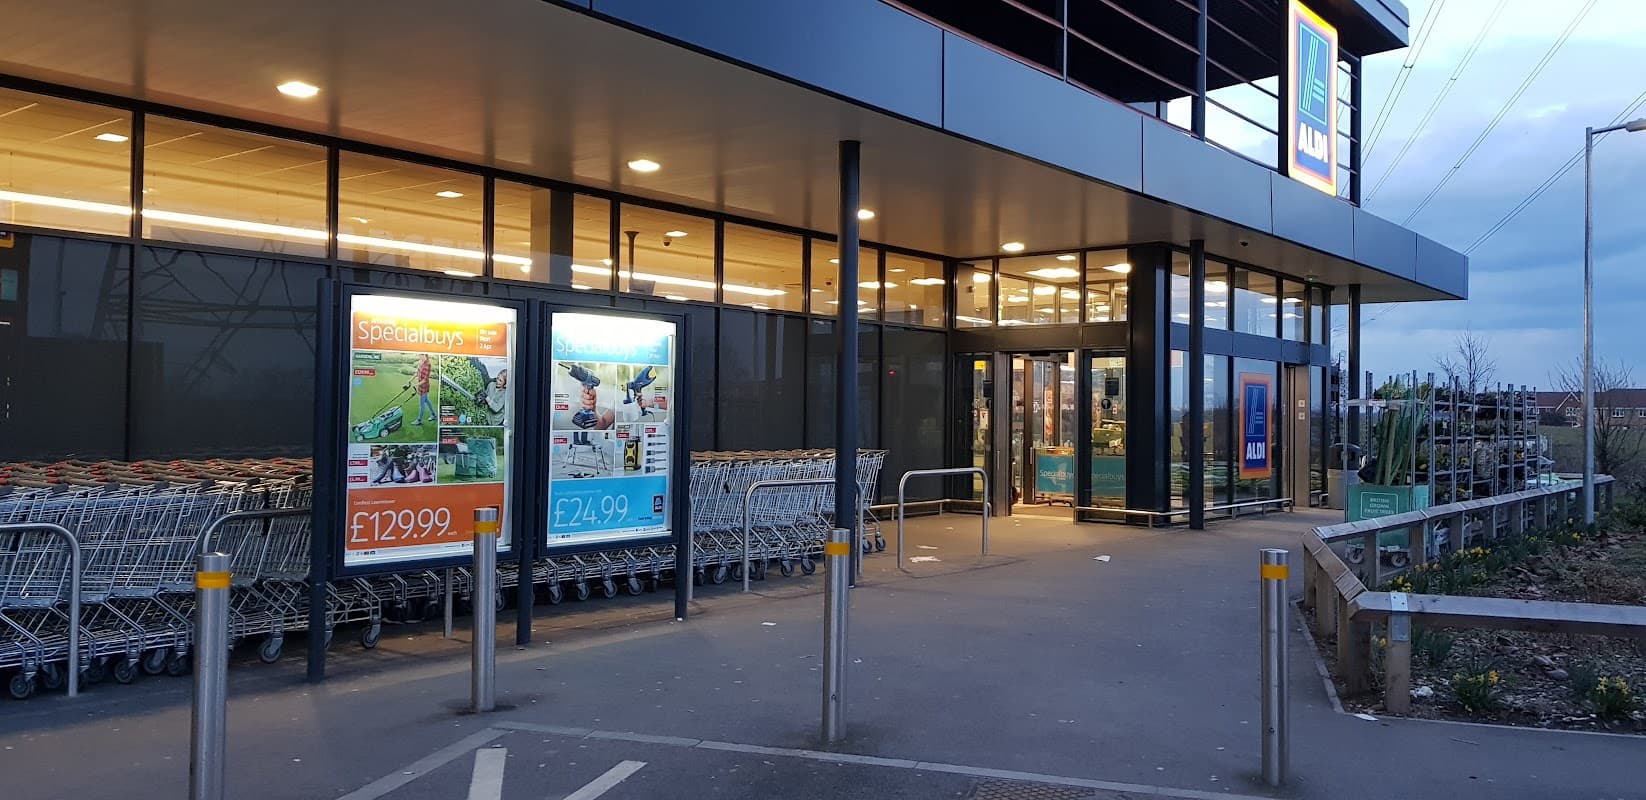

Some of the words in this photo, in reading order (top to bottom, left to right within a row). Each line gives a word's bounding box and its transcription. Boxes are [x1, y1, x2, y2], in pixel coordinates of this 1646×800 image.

[1298, 121, 1328, 164] ALDI
[358, 321, 464, 350] Specialbuys
[1246, 442, 1265, 460] ALDI
[350, 507, 451, 543] £129.99
[554, 494, 628, 528] £24.99
